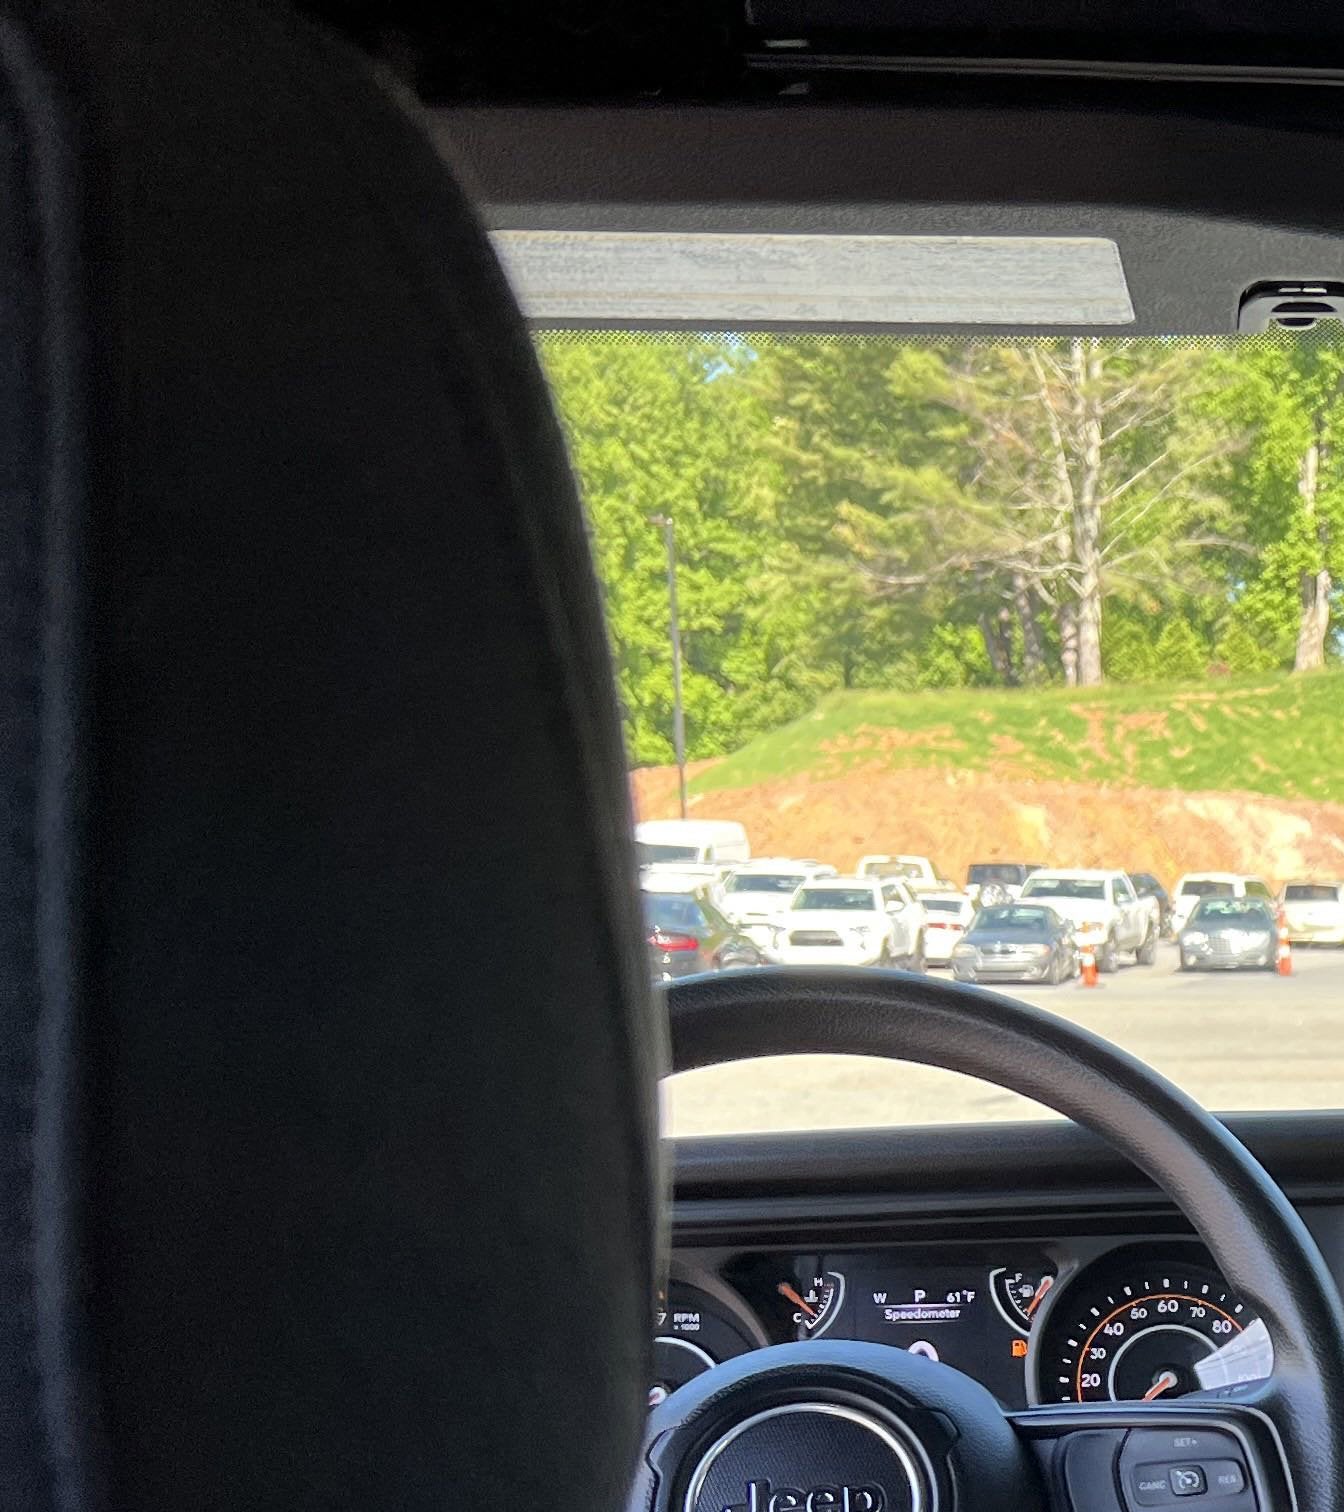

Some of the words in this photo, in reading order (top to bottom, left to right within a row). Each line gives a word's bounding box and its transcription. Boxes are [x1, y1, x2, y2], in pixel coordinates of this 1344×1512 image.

[813, 1277, 823, 1287] H
[873, 1292, 887, 1304] W
[914, 1290, 926, 1303] P
[1157, 1300, 1179, 1313] 60
[1190, 1307, 1206, 1319] 70
[673, 1312, 700, 1323] RPM
[793, 1313, 802, 1323] C
[884, 1308, 961, 1321] Speedometer
[1130, 1307, 1147, 1320] 50
[1104, 1322, 1124, 1336] 40
[1212, 1320, 1232, 1334] 80
[1090, 1347, 1106, 1360] 30
[1081, 1374, 1101, 1388] 20
